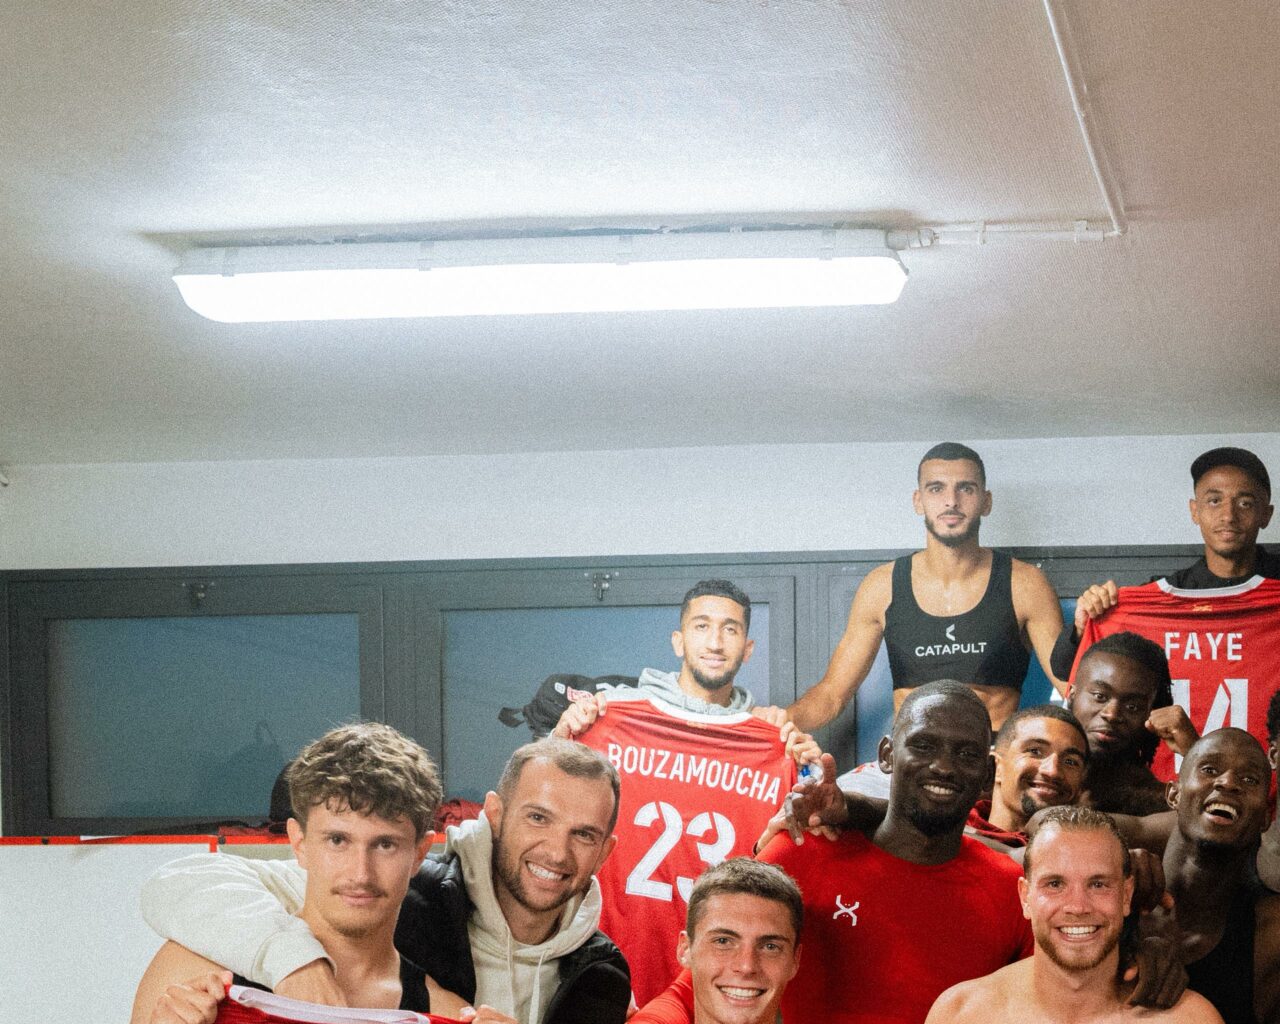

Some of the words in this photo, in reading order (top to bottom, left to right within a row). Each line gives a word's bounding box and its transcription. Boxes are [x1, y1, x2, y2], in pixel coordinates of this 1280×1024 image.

[915, 642, 987, 657] CATAPULT
[1164, 632, 1243, 660] FAYE
[607, 743, 781, 805] BOUZAMOUCHA
